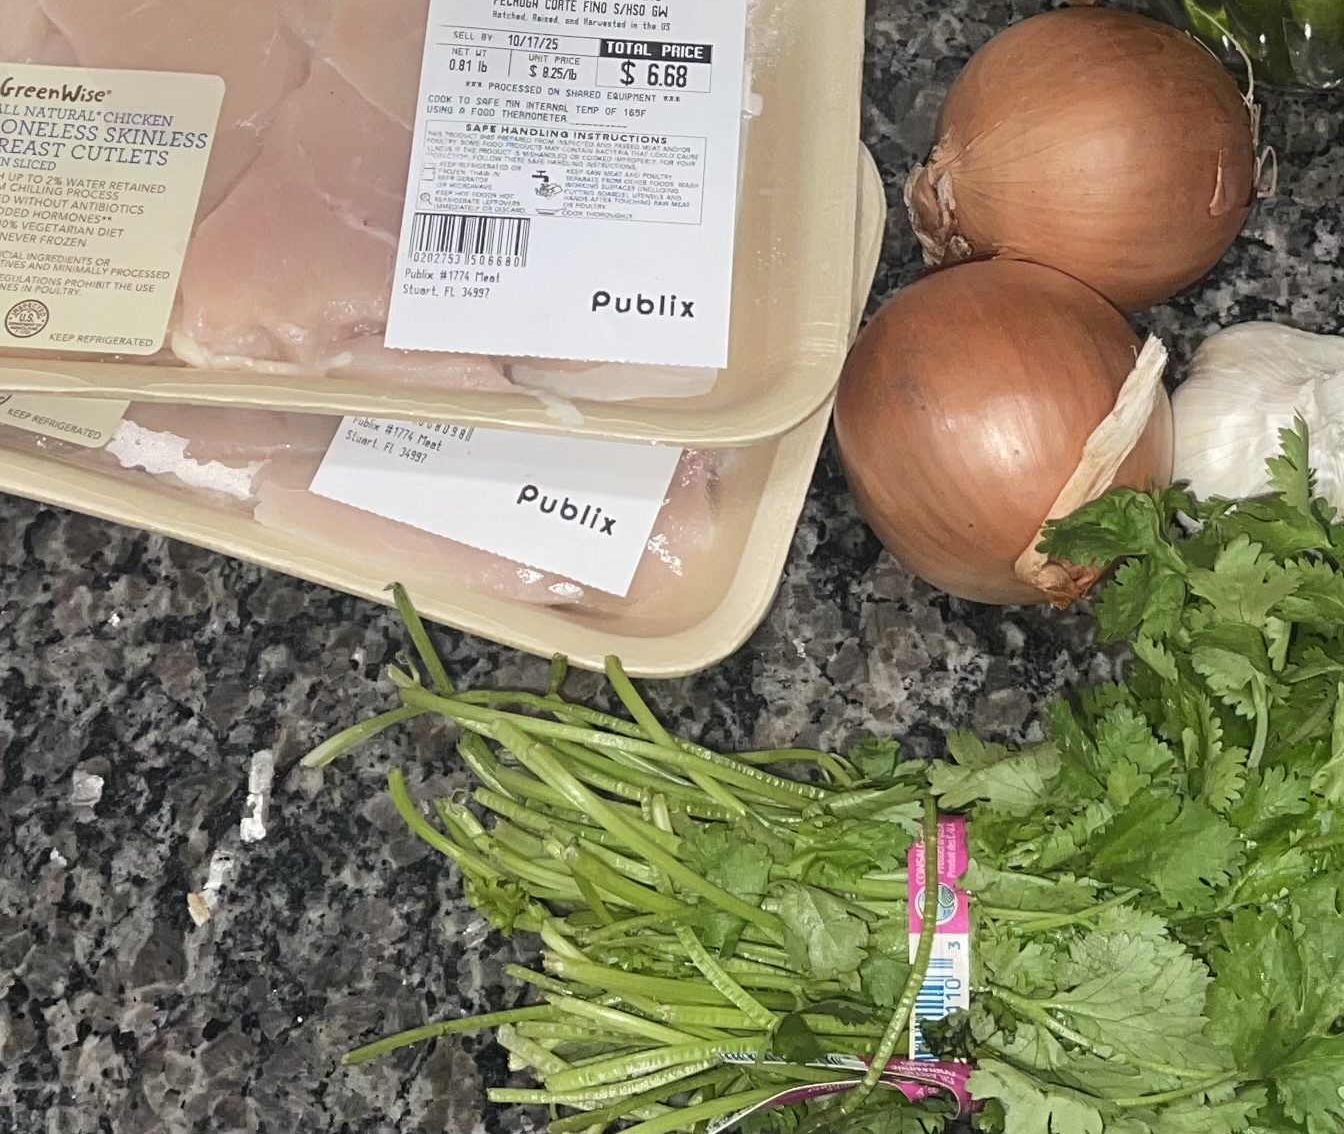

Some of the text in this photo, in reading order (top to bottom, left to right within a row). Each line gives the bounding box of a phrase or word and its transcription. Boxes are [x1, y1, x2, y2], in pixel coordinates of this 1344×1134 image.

[583, 0, 607, 14] FINO
[652, 6, 668, 18] GW
[507, 35, 559, 50] 10/17/25
[606, 41, 704, 59] TOTAL PRICE
[448, 59, 488, 73] 0.81 lb
[529, 65, 577, 81] $ 8.25/lb
[620, 59, 688, 89] $ 6.68
[103, 111, 174, 127] CHICKEN
[103, 126, 208, 149] SKINLESS
[465, 123, 668, 144] SAFE HANDLING INSTRUCTIONS
[12, 157, 57, 171] SLICED
[71, 145, 170, 166] CUTLETS
[404, 269, 501, 284] Publix #1774 Meat
[444, 287, 457, 298] FL
[462, 287, 490, 299] 34997
[591, 291, 695, 318] Publix
[517, 484, 617, 535] Publix
